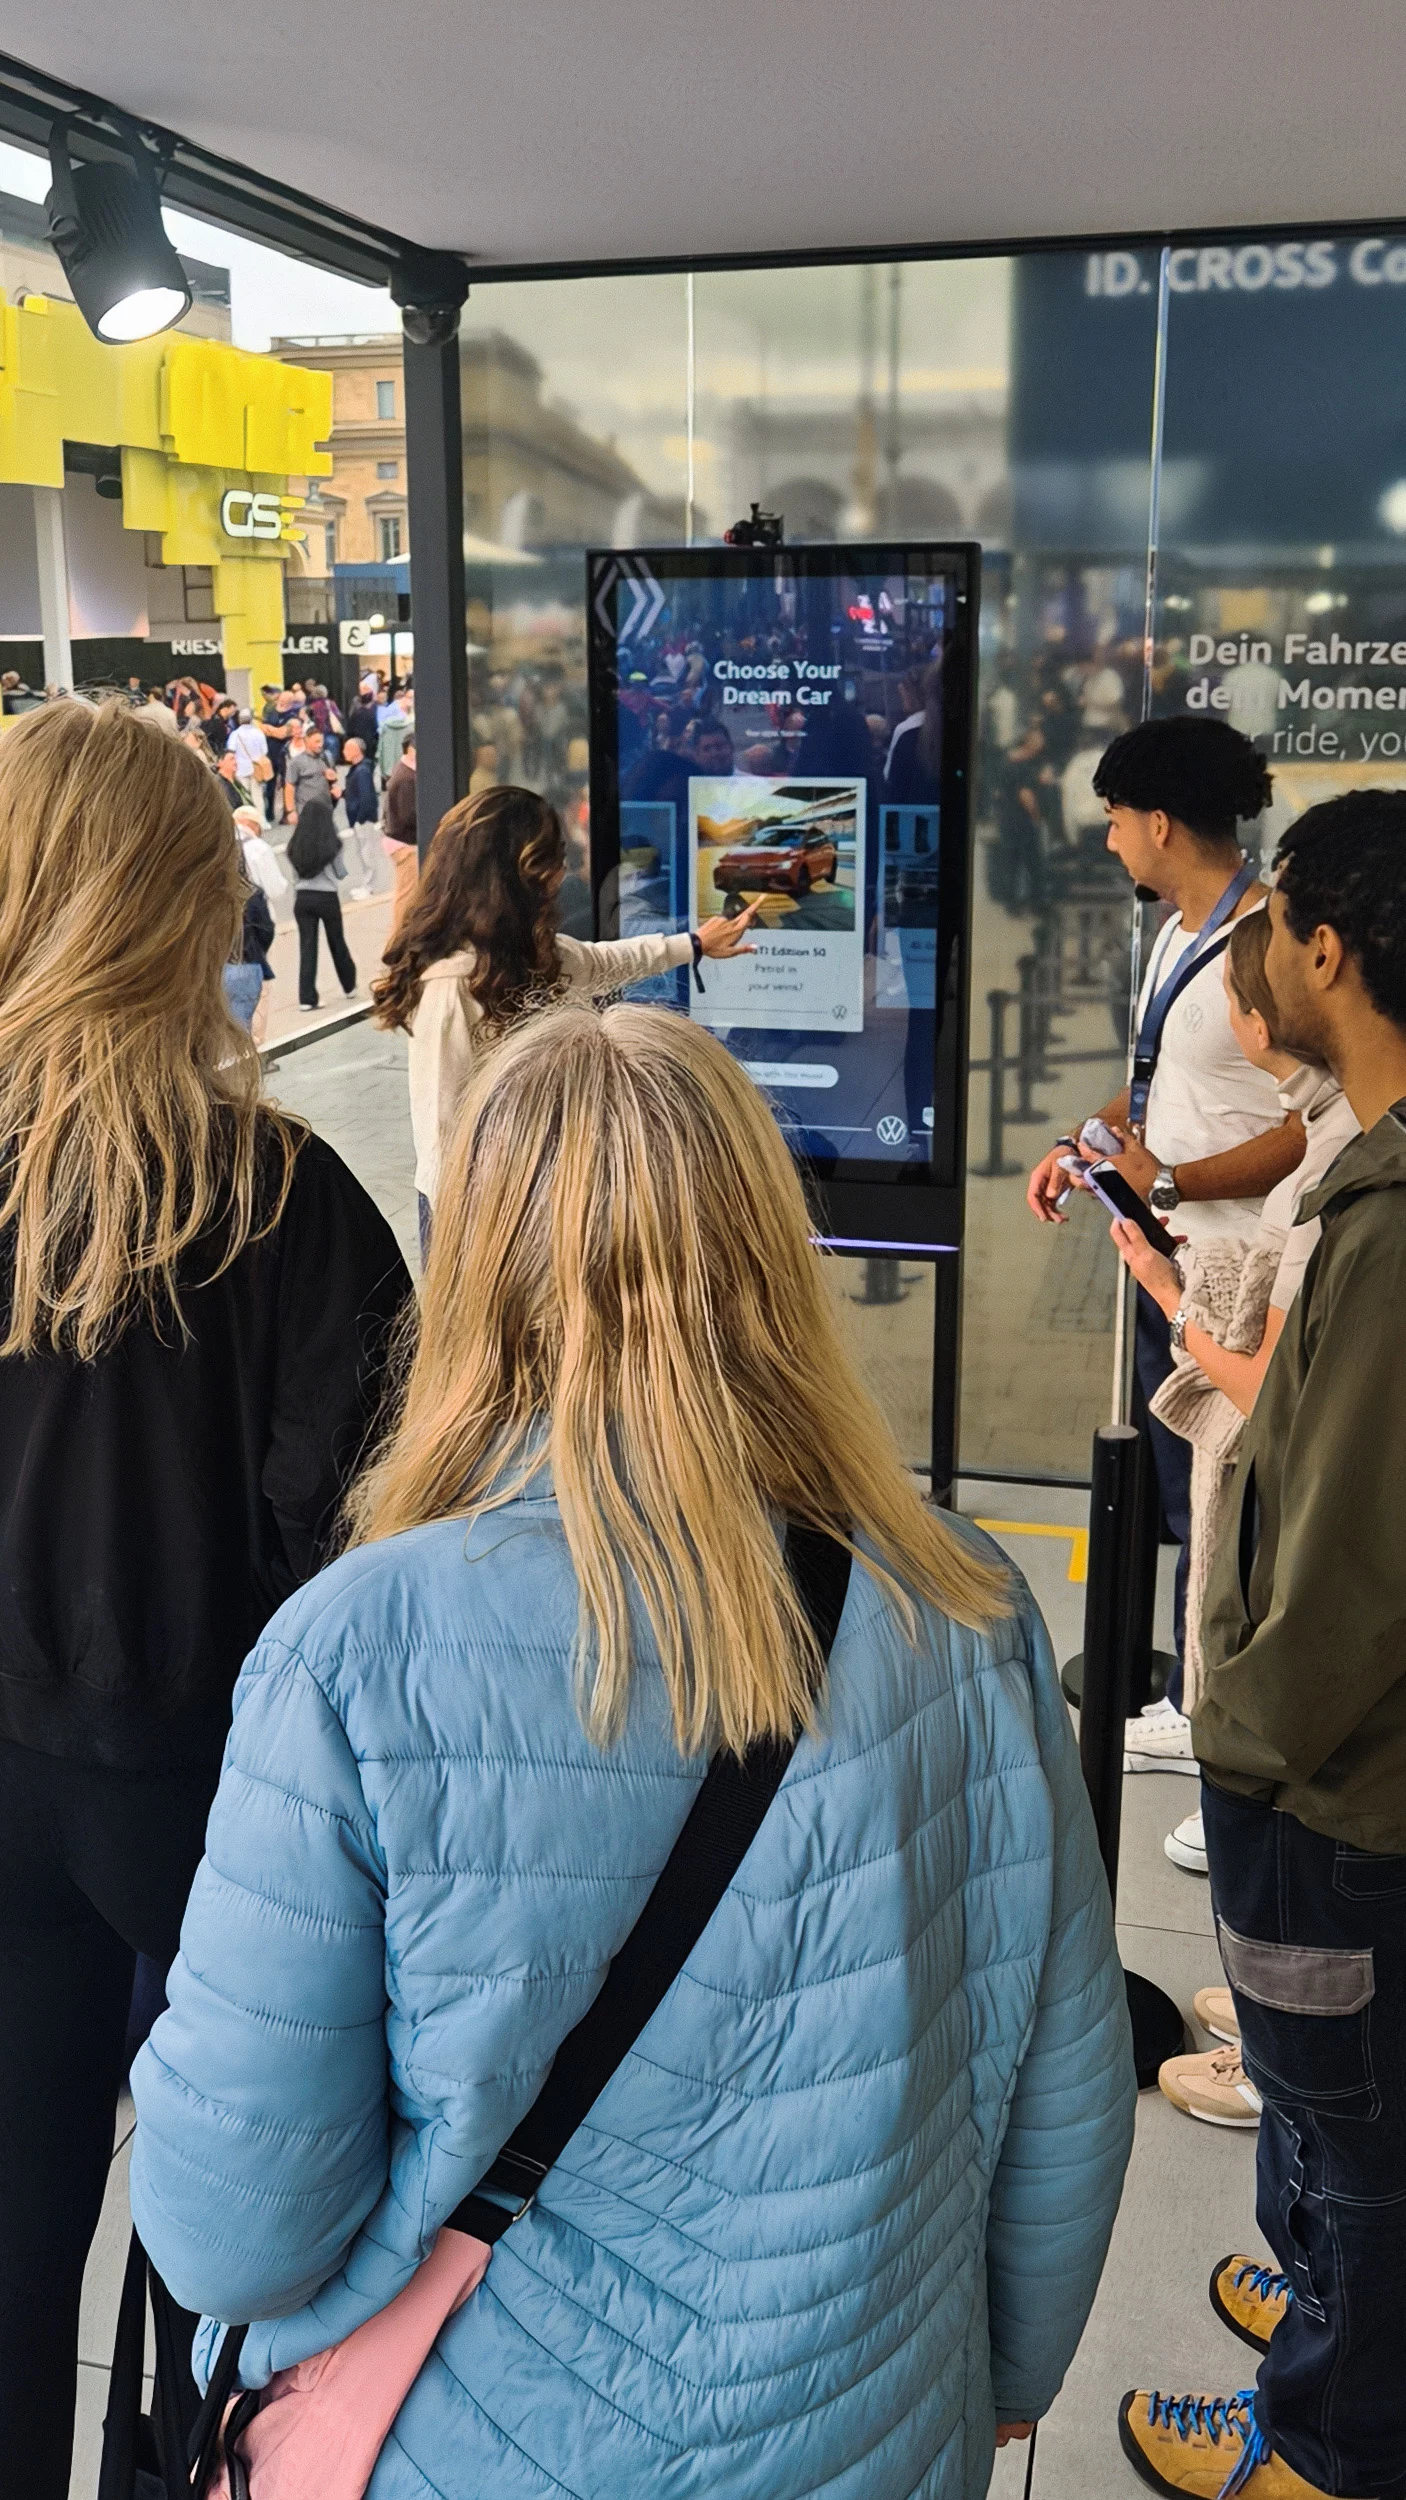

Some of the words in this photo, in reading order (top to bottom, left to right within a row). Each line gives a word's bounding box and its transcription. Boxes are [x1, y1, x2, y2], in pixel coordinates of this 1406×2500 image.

[1086, 251, 1151, 297] ID.
[1166, 241, 1337, 293] CROSS
[1189, 633, 1273, 665] Dein
[1284, 633, 1406, 665] Fahrze
[713, 660, 790, 680] Choose
[793, 660, 842, 680] Your
[723, 686, 792, 706] Dream
[796, 686, 833, 706] Car
[1273, 724, 1346, 761] ride,
[1360, 731, 1406, 763] yo
[771, 947, 809, 956] Edition
